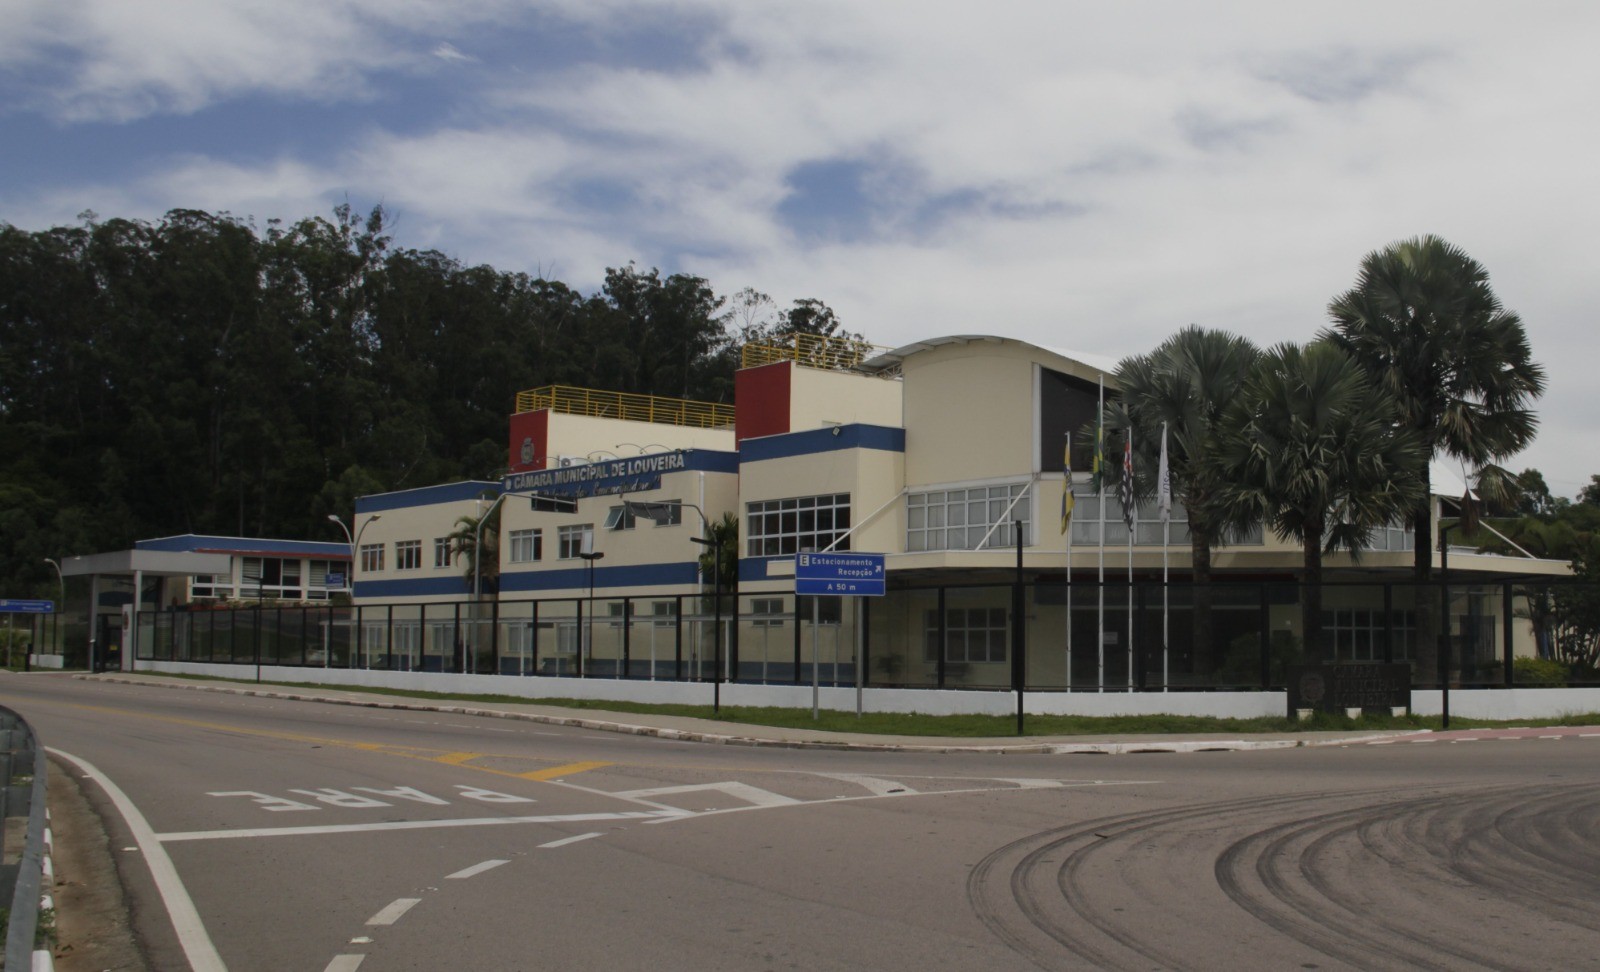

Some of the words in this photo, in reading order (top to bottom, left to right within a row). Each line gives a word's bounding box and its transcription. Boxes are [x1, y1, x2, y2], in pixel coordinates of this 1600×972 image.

[514, 472, 552, 489] CÂMARA
[555, 465, 608, 484] MUNICIPAL
[611, 462, 626, 477] DE
[628, 454, 685, 475] LOUVEIRA
[811, 557, 873, 566] Estacionamento
[838, 568, 873, 577] Recepção
[827, 583, 833, 591] A
[836, 583, 846, 591] 50
